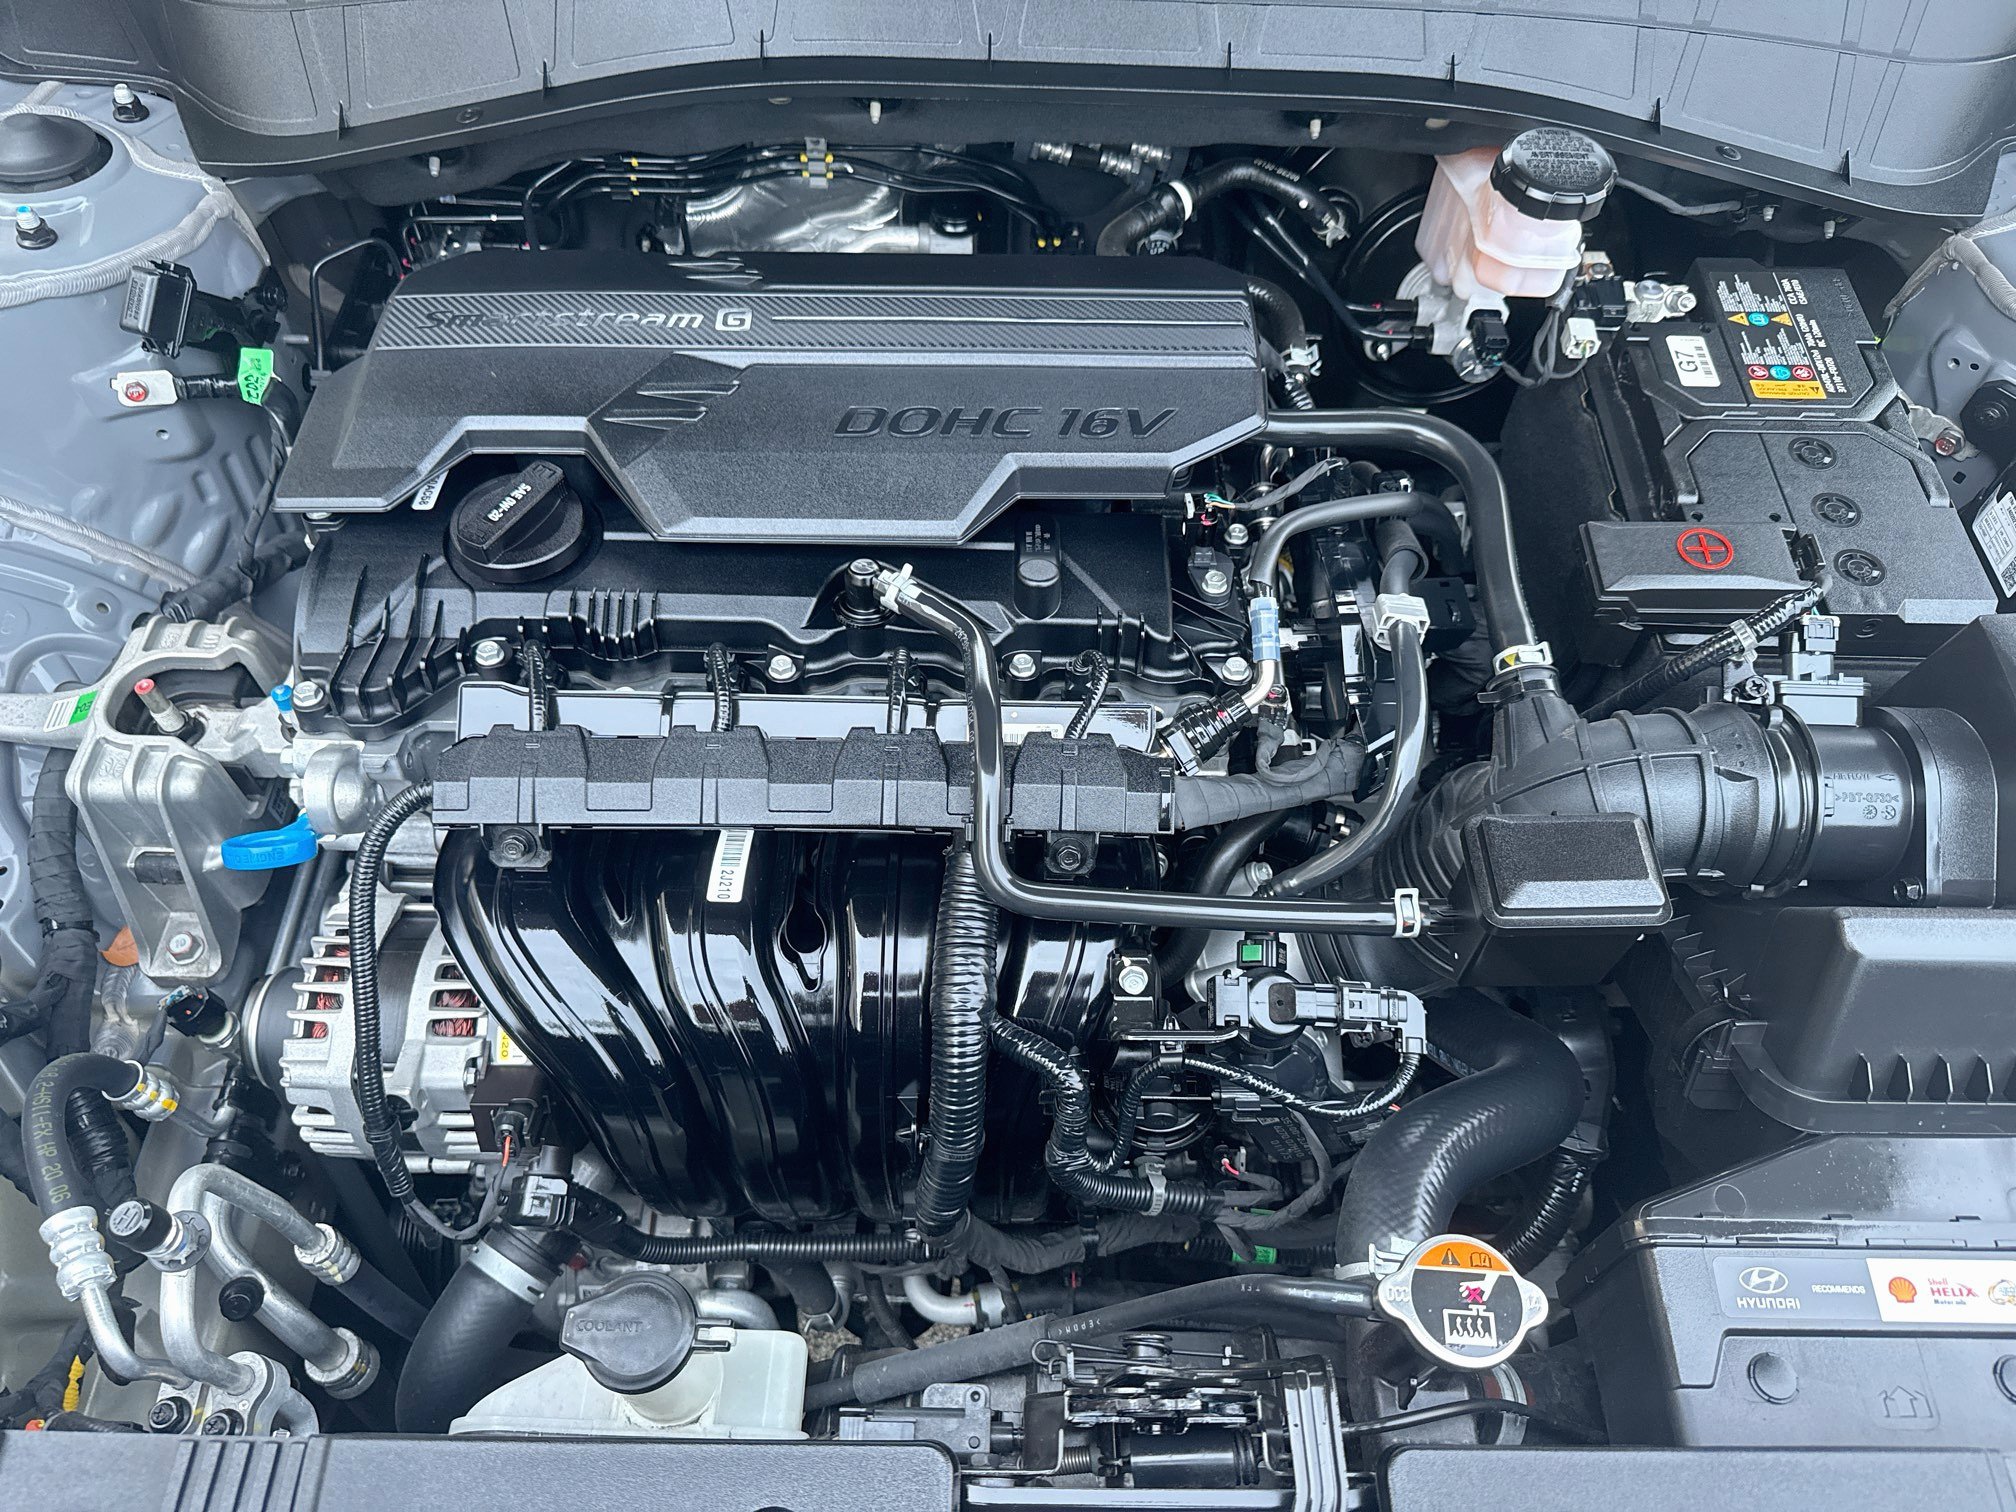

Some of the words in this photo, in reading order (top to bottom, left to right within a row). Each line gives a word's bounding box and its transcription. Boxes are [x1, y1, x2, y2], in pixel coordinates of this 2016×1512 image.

[416, 308, 705, 330] Smartstream
[716, 308, 752, 331] G
[1674, 350, 1699, 373] G7
[833, 405, 1042, 438] DOHC
[1058, 405, 1179, 438] 16V
[511, 482, 532, 501] SAE
[487, 496, 518, 523] 0W-20
[717, 869, 735, 900] 2J210
[35, 1142, 58, 1158] HP
[41, 1162, 64, 1182] 20
[48, 1184, 72, 1205] 06
[1811, 1284, 1866, 1295] RECOMMENDS
[1930, 1286, 1977, 1298] HELIX
[1736, 1296, 1801, 1310] HYUNDAI
[576, 1319, 643, 1333] COOLANT
